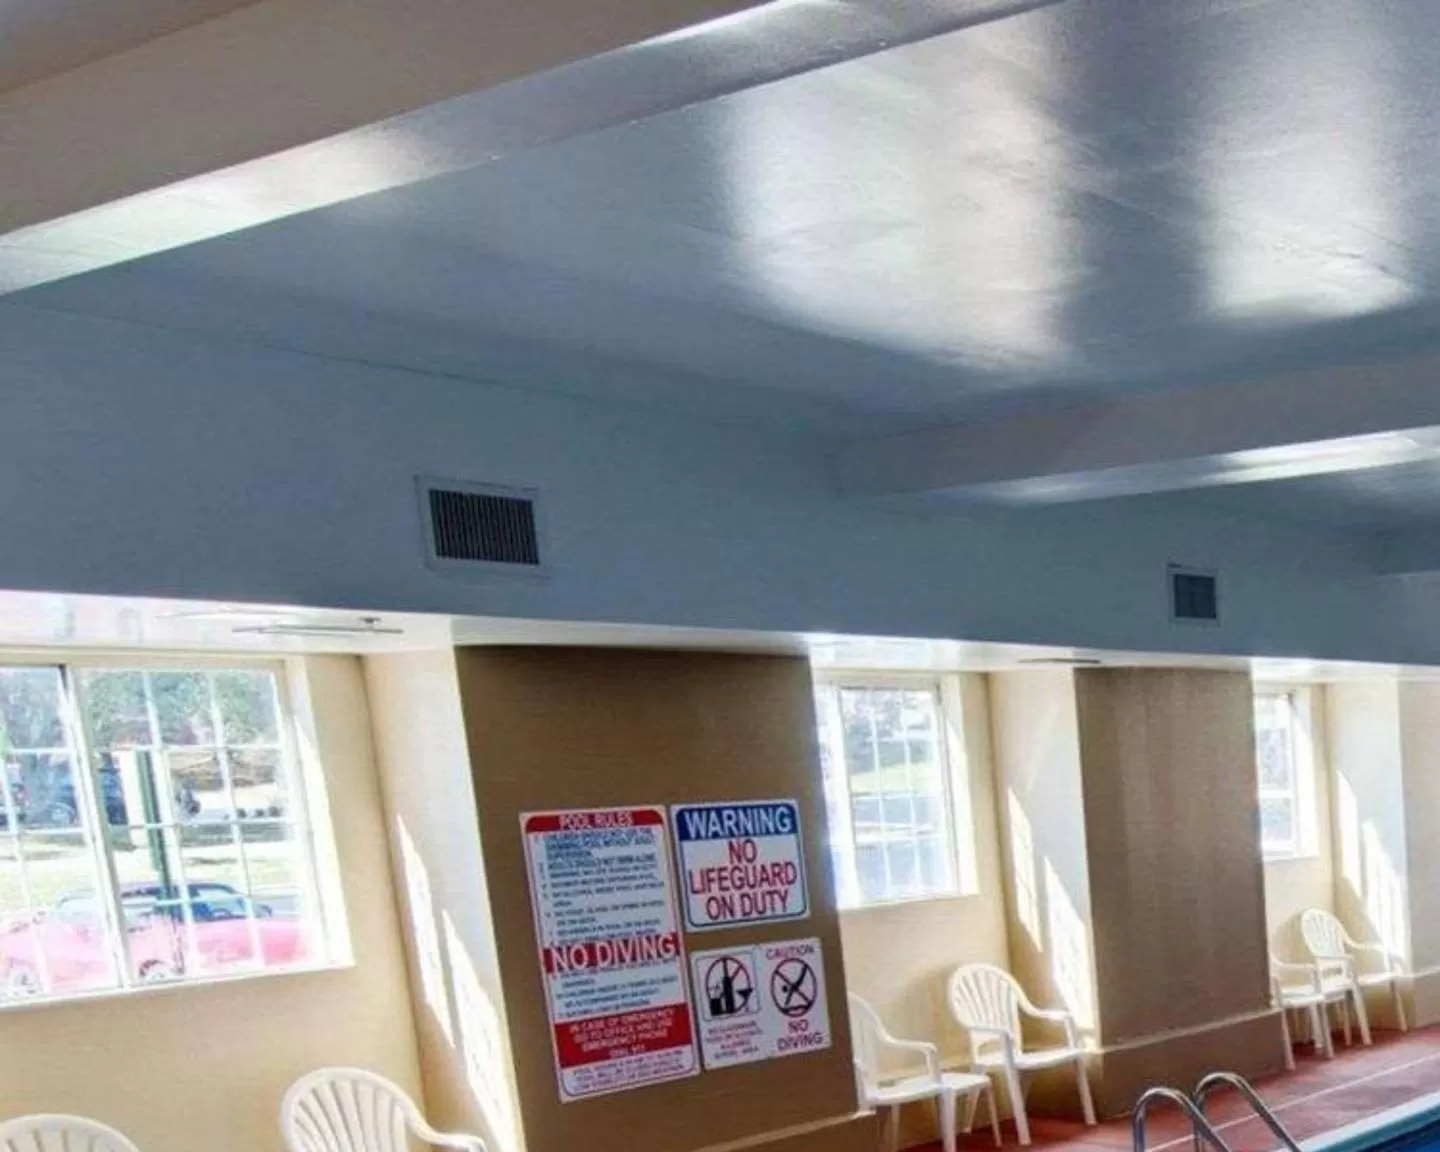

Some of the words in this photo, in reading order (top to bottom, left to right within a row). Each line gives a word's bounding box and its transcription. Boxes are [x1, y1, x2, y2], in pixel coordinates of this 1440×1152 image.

[684, 806, 791, 838] WARNING
[729, 839, 757, 864] NO
[689, 862, 797, 894] LIFEGUARD
[706, 896, 734, 920] ON
[740, 889, 788, 917] DUTY
[552, 942, 589, 973] NO
[596, 935, 676, 967] DIVING
[766, 944, 815, 960] CAUTION
[788, 1019, 809, 1033] NO
[777, 1031, 822, 1051] DIVING
